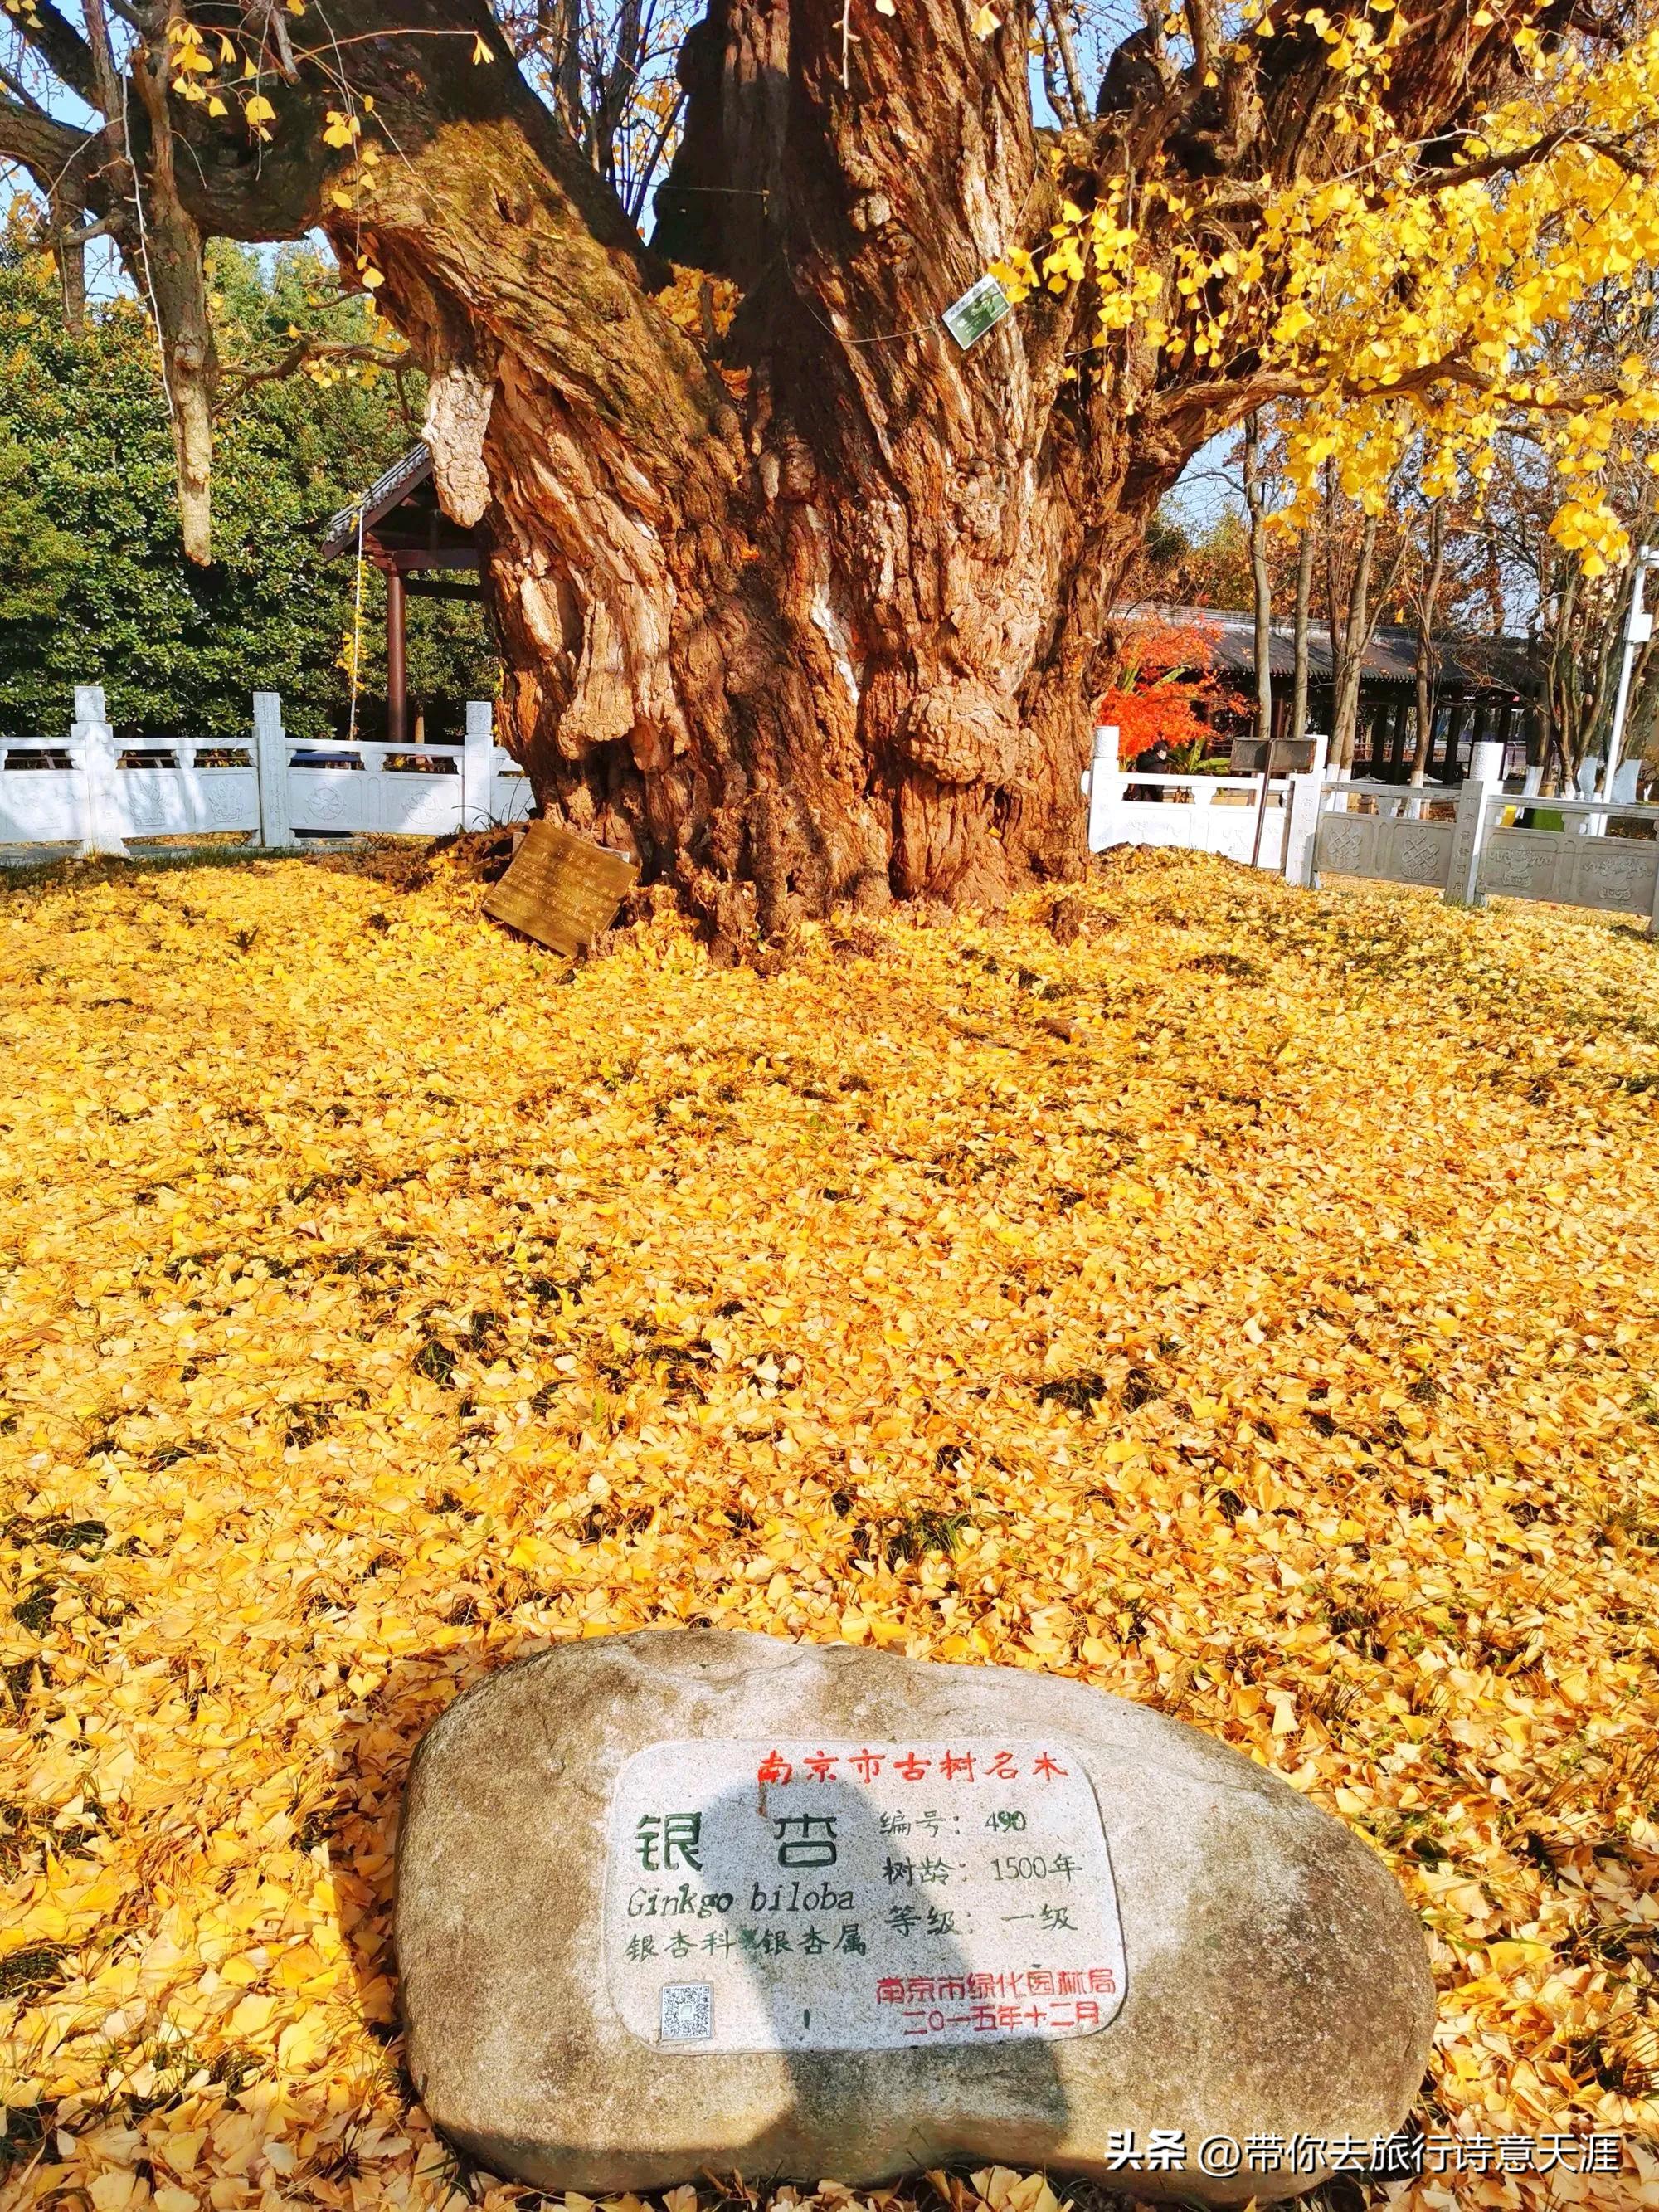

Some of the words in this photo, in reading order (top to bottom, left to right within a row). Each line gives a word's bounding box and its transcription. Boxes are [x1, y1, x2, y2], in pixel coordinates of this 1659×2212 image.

[757, 1748, 1069, 1784] 南京市古树名木
[635, 1811, 837, 1872] 银杏
[990, 1853, 1082, 1882] 1500年
[628, 1883, 734, 1919] Ginkgo
[749, 1881, 856, 1912] biloba
[1000, 1903, 1078, 1932] 一级
[625, 1927, 737, 1962] 银杏科
[755, 1922, 867, 1956] 银杏属
[876, 1968, 1116, 2005] 南京市绿化园林局
